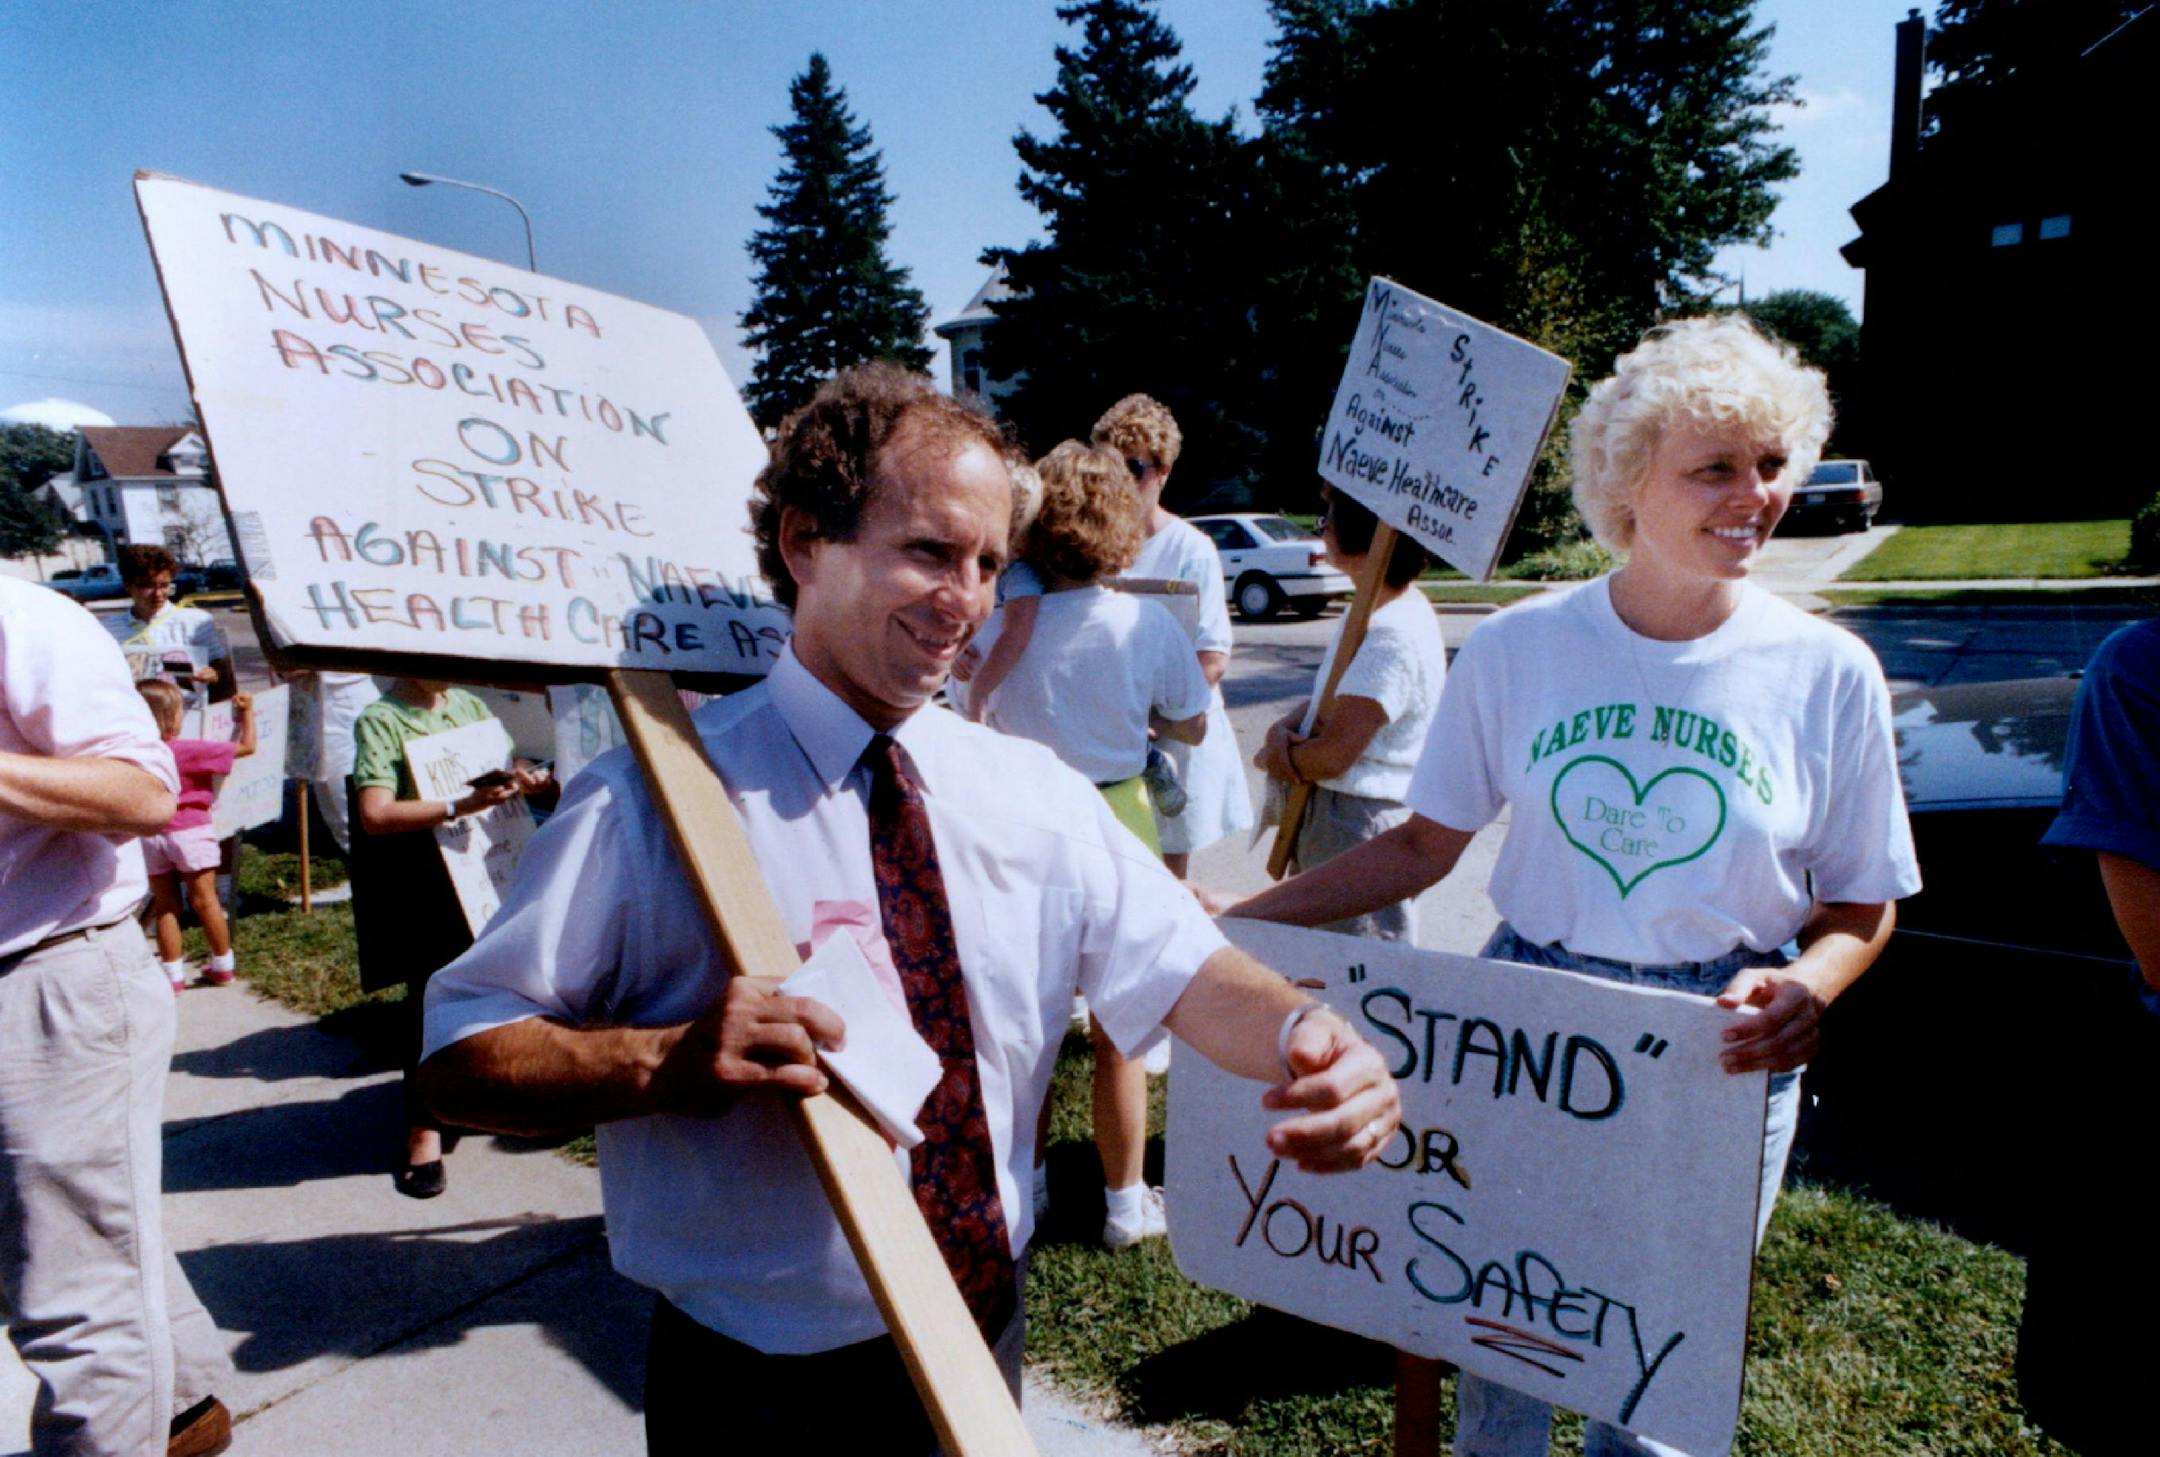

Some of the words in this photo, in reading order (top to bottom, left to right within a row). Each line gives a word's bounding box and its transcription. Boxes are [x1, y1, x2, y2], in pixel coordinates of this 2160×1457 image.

[218, 212, 602, 339] MINNESOTA
[248, 268, 546, 371] NURSES
[271, 328, 672, 446] ASSOCIATION
[457, 417, 571, 472] ON
[1326, 430, 1388, 485] Naeve
[411, 458, 655, 537] STRIKE
[304, 515, 583, 589] AGAINST
[1650, 705, 1774, 806] NURSES
[1583, 796, 1648, 827] Dare
[1656, 805, 1686, 834] To
[1599, 828, 1660, 858] Care
